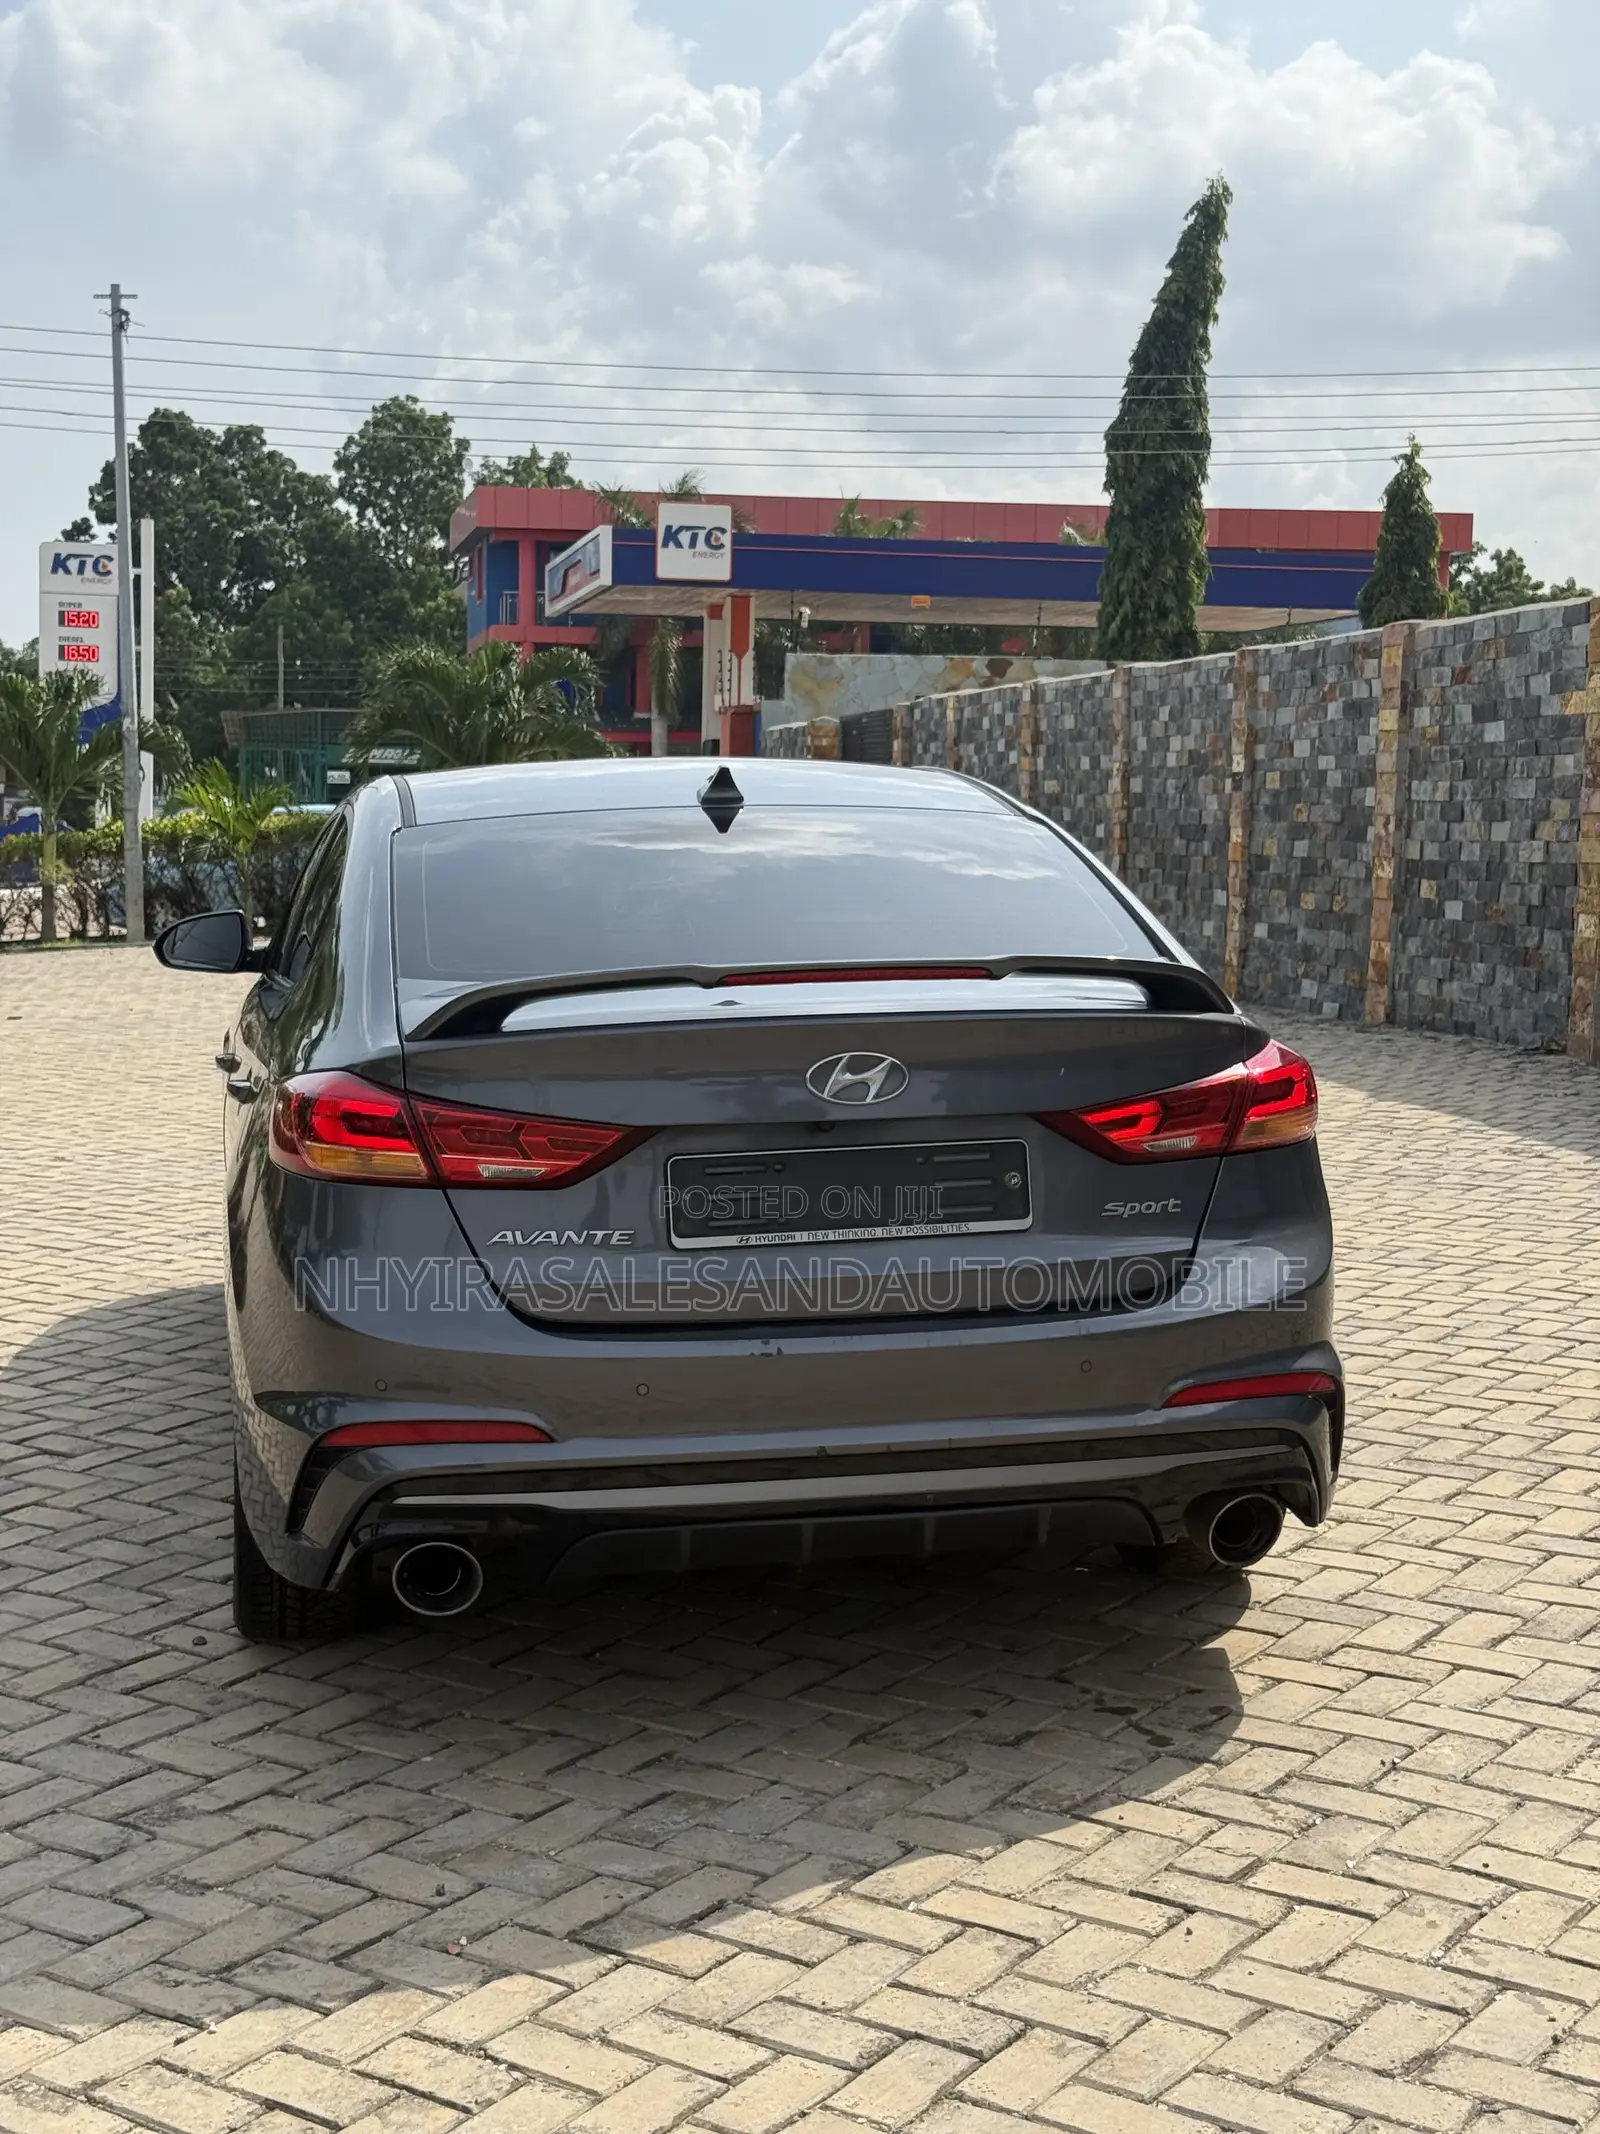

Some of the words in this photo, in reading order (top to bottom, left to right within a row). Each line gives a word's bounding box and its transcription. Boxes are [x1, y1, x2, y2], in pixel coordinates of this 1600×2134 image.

[660, 524, 728, 551] KTC
[50, 553, 114, 577] KTC
[691, 551, 726, 560] ENERGY
[80, 577, 113, 585] ENERGY
[1100, 1198, 1182, 1219] Sport
[486, 1230, 635, 1246] AVANTE
[754, 1233, 796, 1243] HYUNDAI
[808, 1231, 830, 1241] NEW
[832, 1227, 879, 1239] THINKING.
[881, 1226, 905, 1236] NEW
[906, 1223, 973, 1235] POSSIBILITIES.
